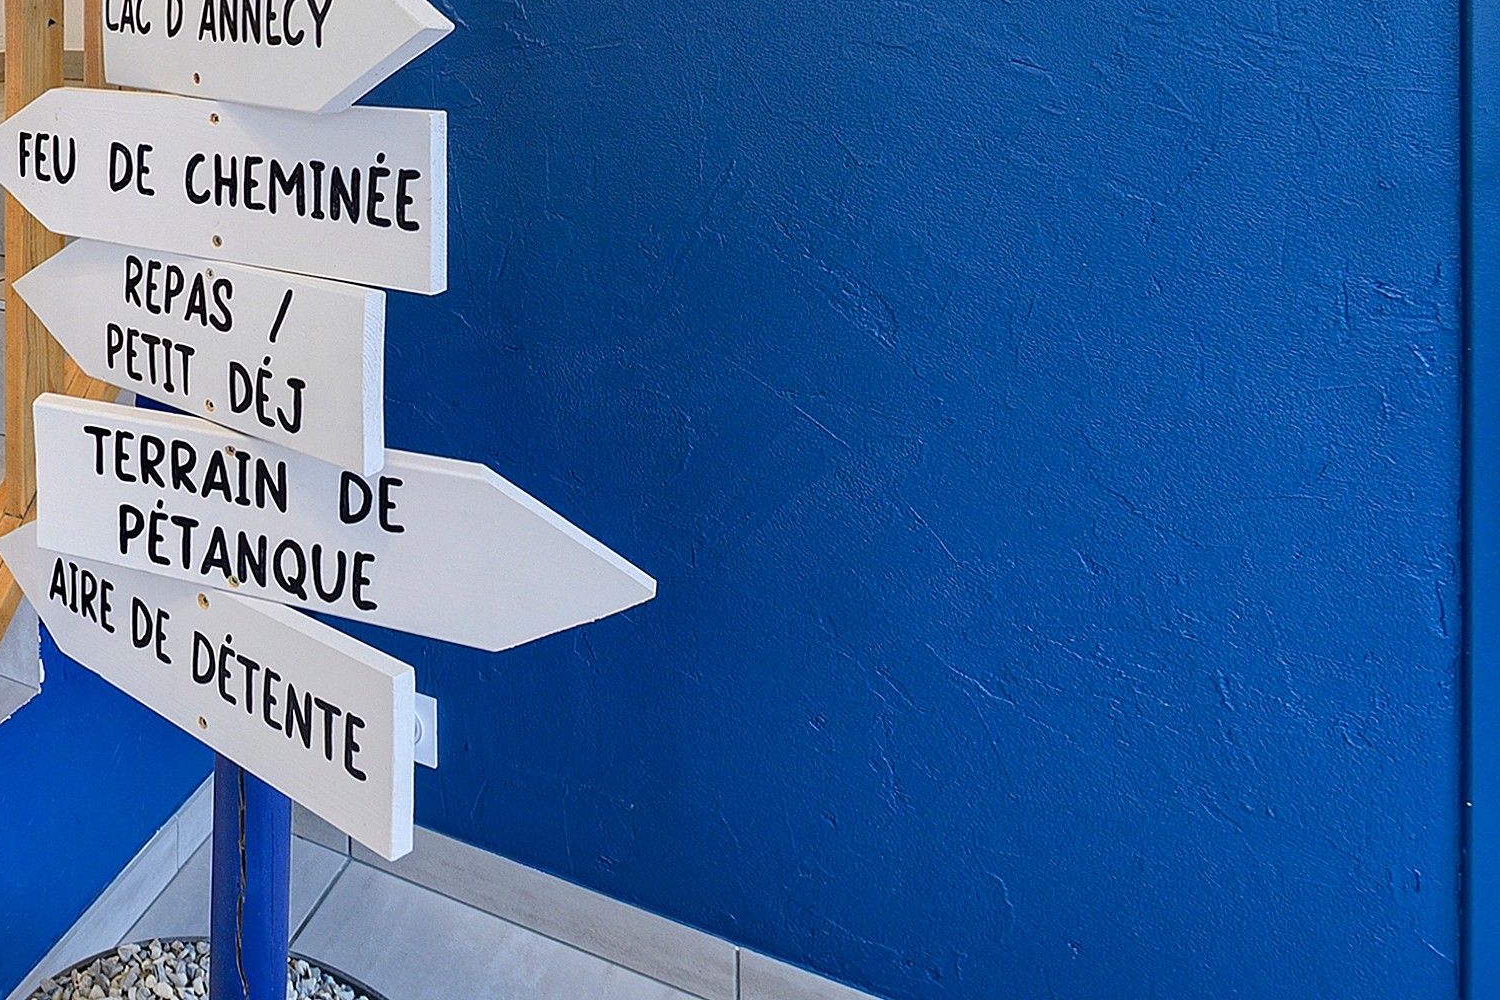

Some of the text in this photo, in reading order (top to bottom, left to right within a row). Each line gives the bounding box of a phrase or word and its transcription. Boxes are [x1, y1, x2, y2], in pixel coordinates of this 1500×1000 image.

[19, 131, 422, 232] FEU DE CHEMINÉE
[125, 255, 233, 333] REPAS
[107, 322, 306, 434] PETIT DÉJ
[83, 425, 406, 534] TERRAIN DE
[119, 499, 378, 612] PÉTANQUE
[49, 557, 368, 782] AIRE DE DÉTENTE
